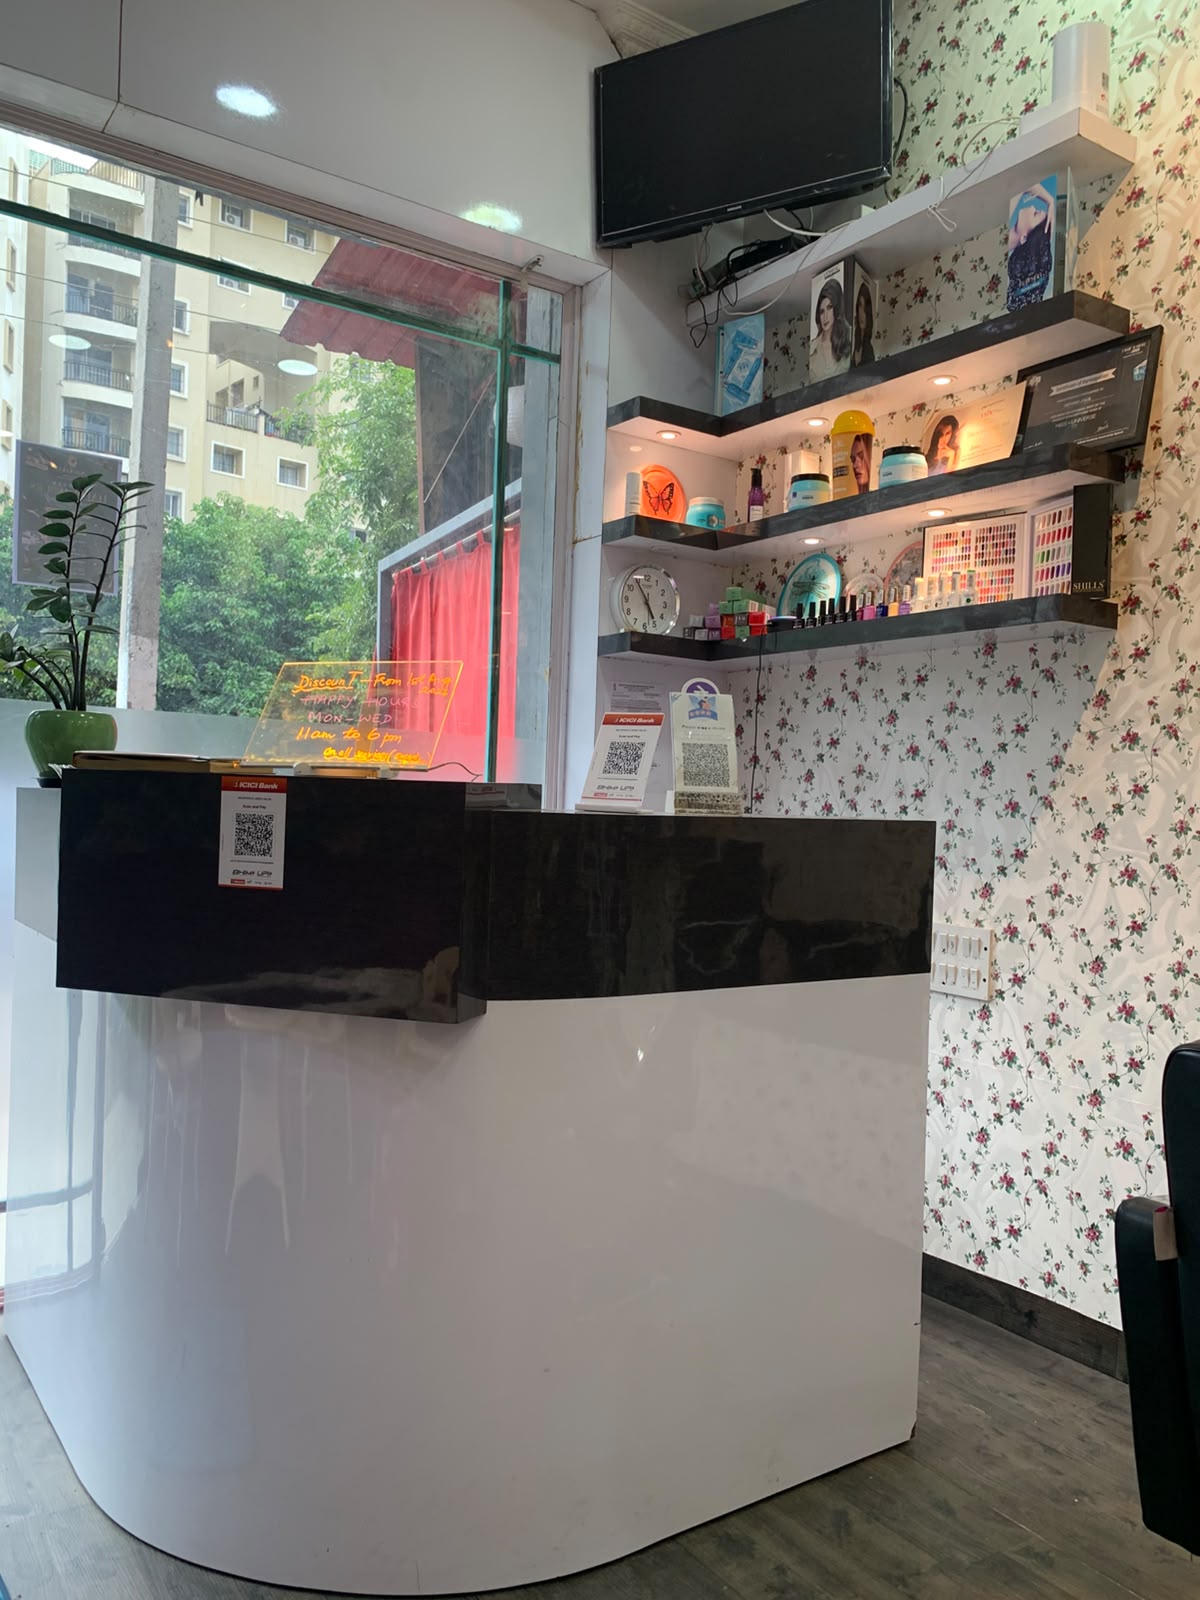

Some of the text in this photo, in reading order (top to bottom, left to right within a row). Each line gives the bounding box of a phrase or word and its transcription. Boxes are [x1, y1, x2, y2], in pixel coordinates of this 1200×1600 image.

[1073, 581, 1105, 590] SHILLS
[300, 694, 357, 709] HAPPY
[296, 727, 403, 748] 11am to 6 pm
[258, 782, 279, 790] Bank
